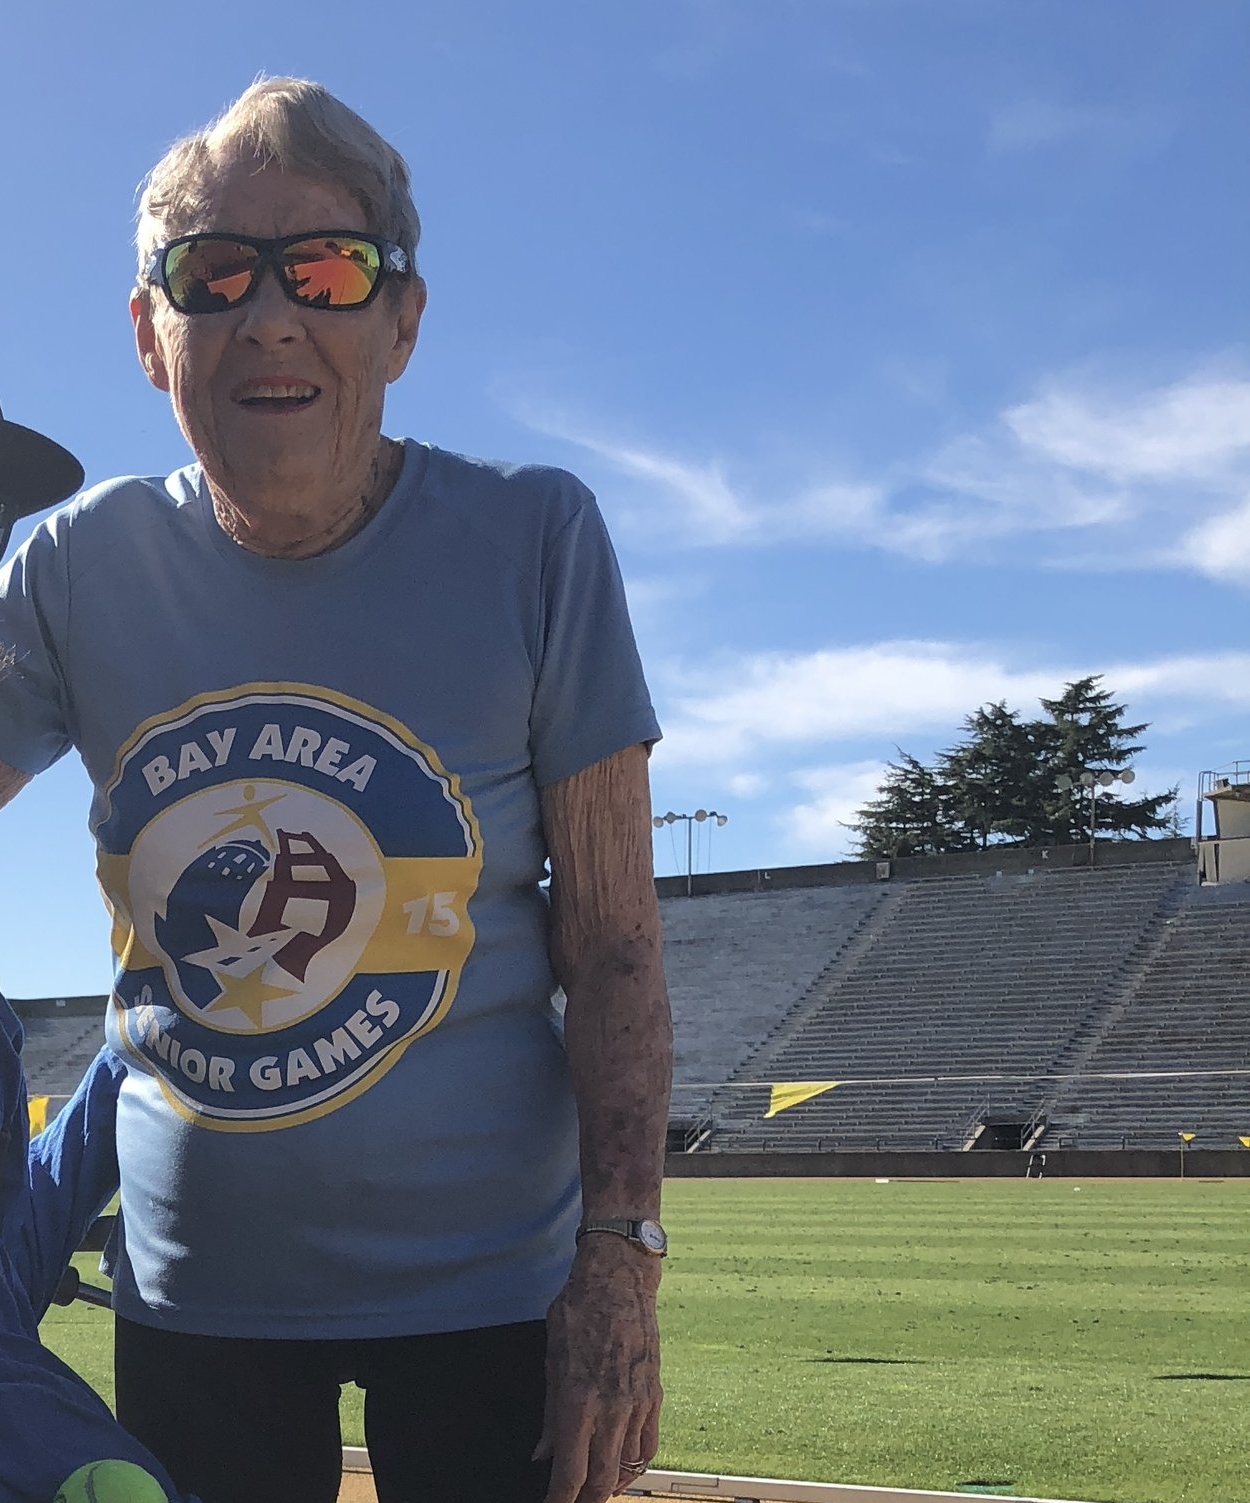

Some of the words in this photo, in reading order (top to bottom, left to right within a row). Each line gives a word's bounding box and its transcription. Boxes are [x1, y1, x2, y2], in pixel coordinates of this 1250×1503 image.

[141, 726, 238, 797] BAY
[249, 723, 378, 793] AREA
[403, 891, 459, 937] 15
[249, 989, 401, 1092] GAMES
